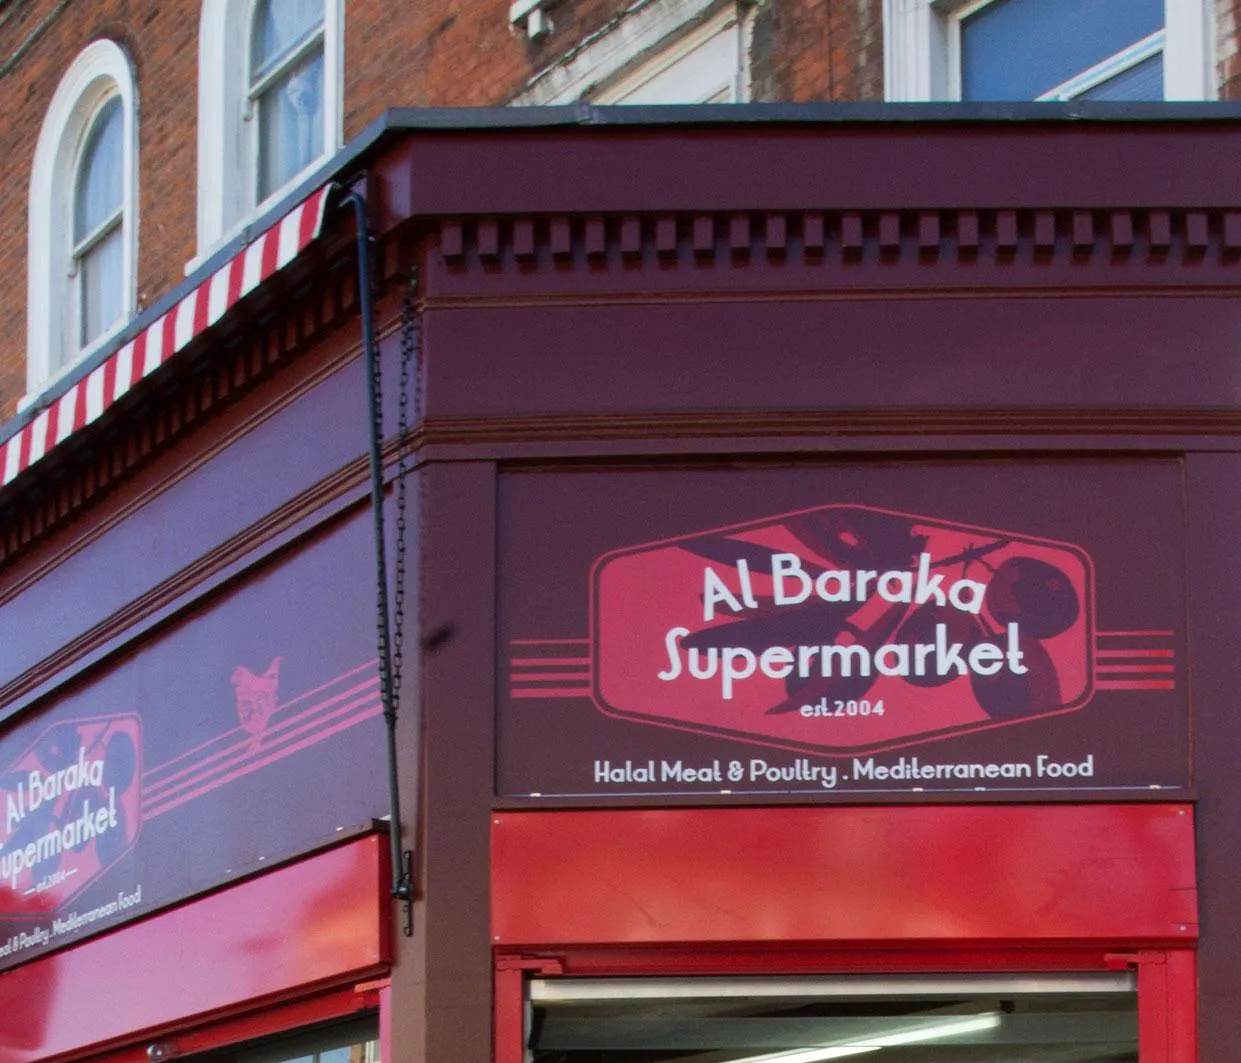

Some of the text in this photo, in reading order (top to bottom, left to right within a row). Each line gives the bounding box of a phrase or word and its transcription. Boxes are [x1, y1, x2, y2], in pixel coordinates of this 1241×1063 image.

[701, 553, 987, 623] Al Baraka
[658, 622, 1028, 699] Supermarket
[6, 746, 104, 834] Al Baraka
[594, 760, 656, 783] Halal
[661, 760, 723, 783] Meat
[728, 760, 744, 782] &
[750, 759, 837, 789] Poultry
[853, 757, 1032, 781] Mediterranean
[1037, 754, 1094, 778] Food
[0, 786, 118, 890] upermarket
